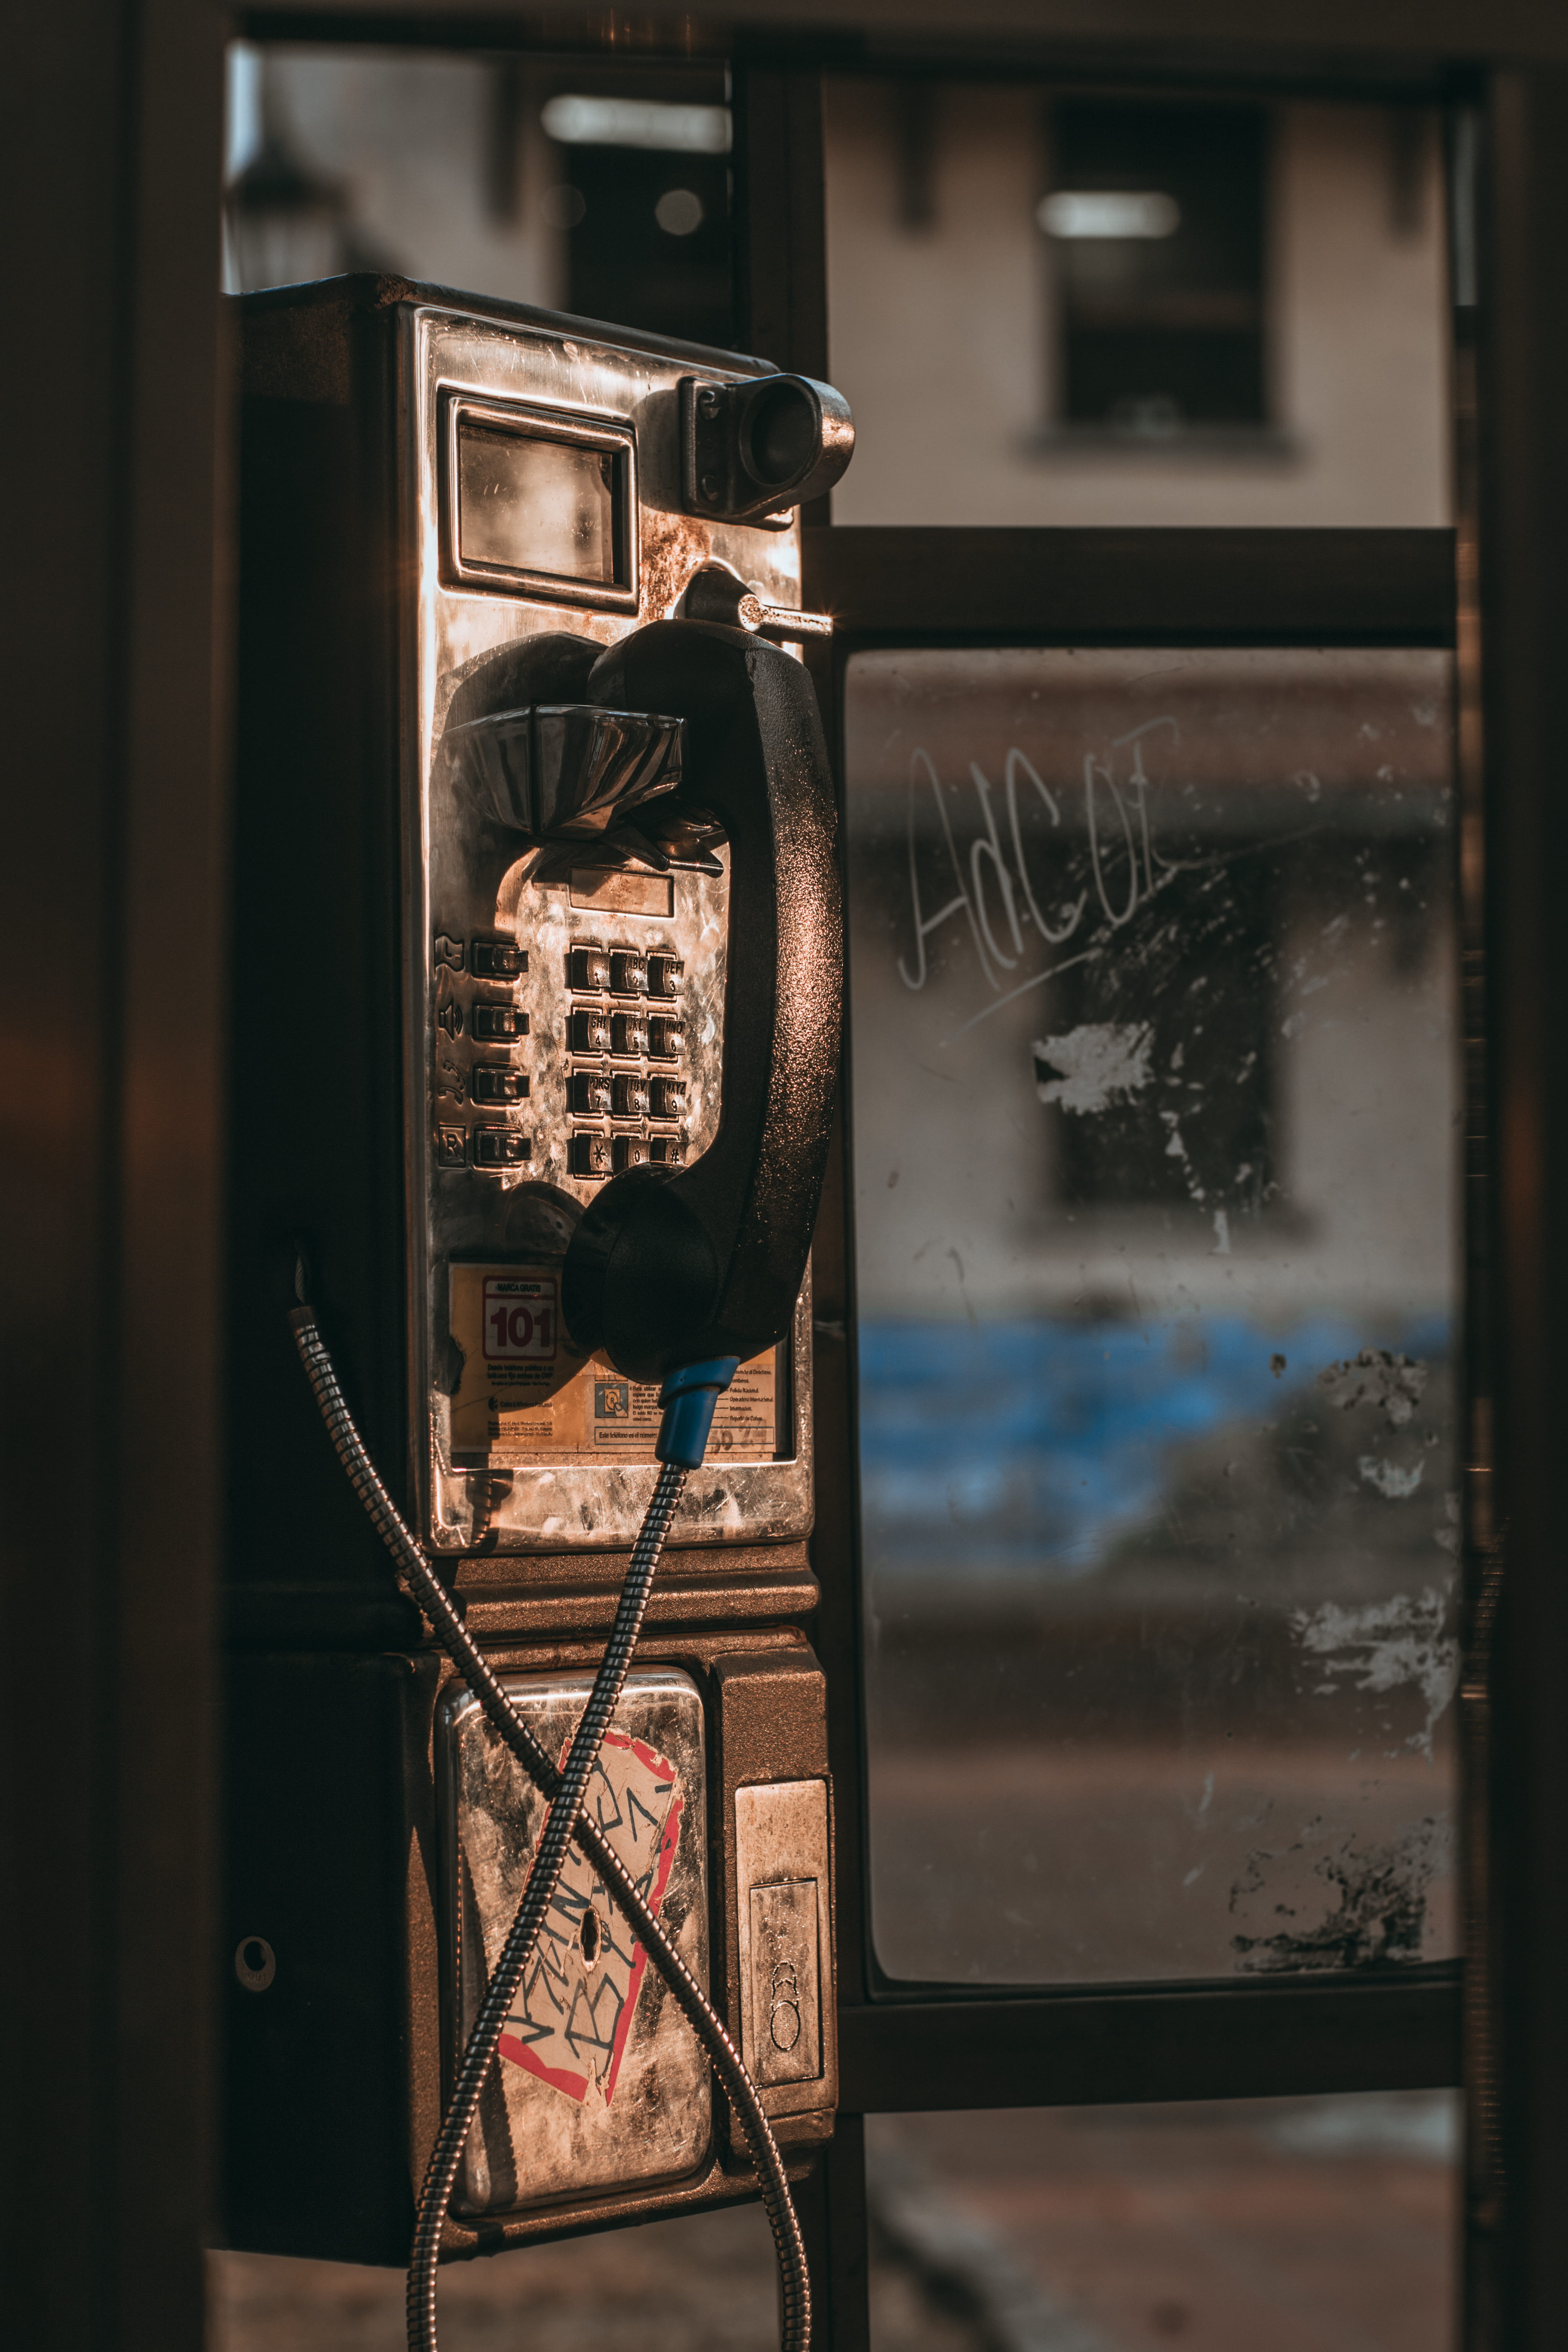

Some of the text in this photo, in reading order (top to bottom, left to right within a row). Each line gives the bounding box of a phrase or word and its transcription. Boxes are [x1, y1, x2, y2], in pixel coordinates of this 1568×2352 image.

[665, 961, 681, 974] DEF
[670, 980, 675, 992] 3
[591, 1016, 606, 1029] GHI
[596, 1035, 601, 1046] 4
[633, 1037, 639, 1049] 5
[671, 1039, 676, 1052] 6
[590, 1077, 610, 1090] PQRS
[630, 1080, 646, 1092] TUV
[595, 1095, 601, 1107] 7
[634, 1098, 640, 1110] 8
[671, 1100, 677, 1112] 9
[447, 1133, 458, 1158] R
[498, 1283, 541, 1292] MARCA GRATIS
[490, 1307, 550, 1348] 101
